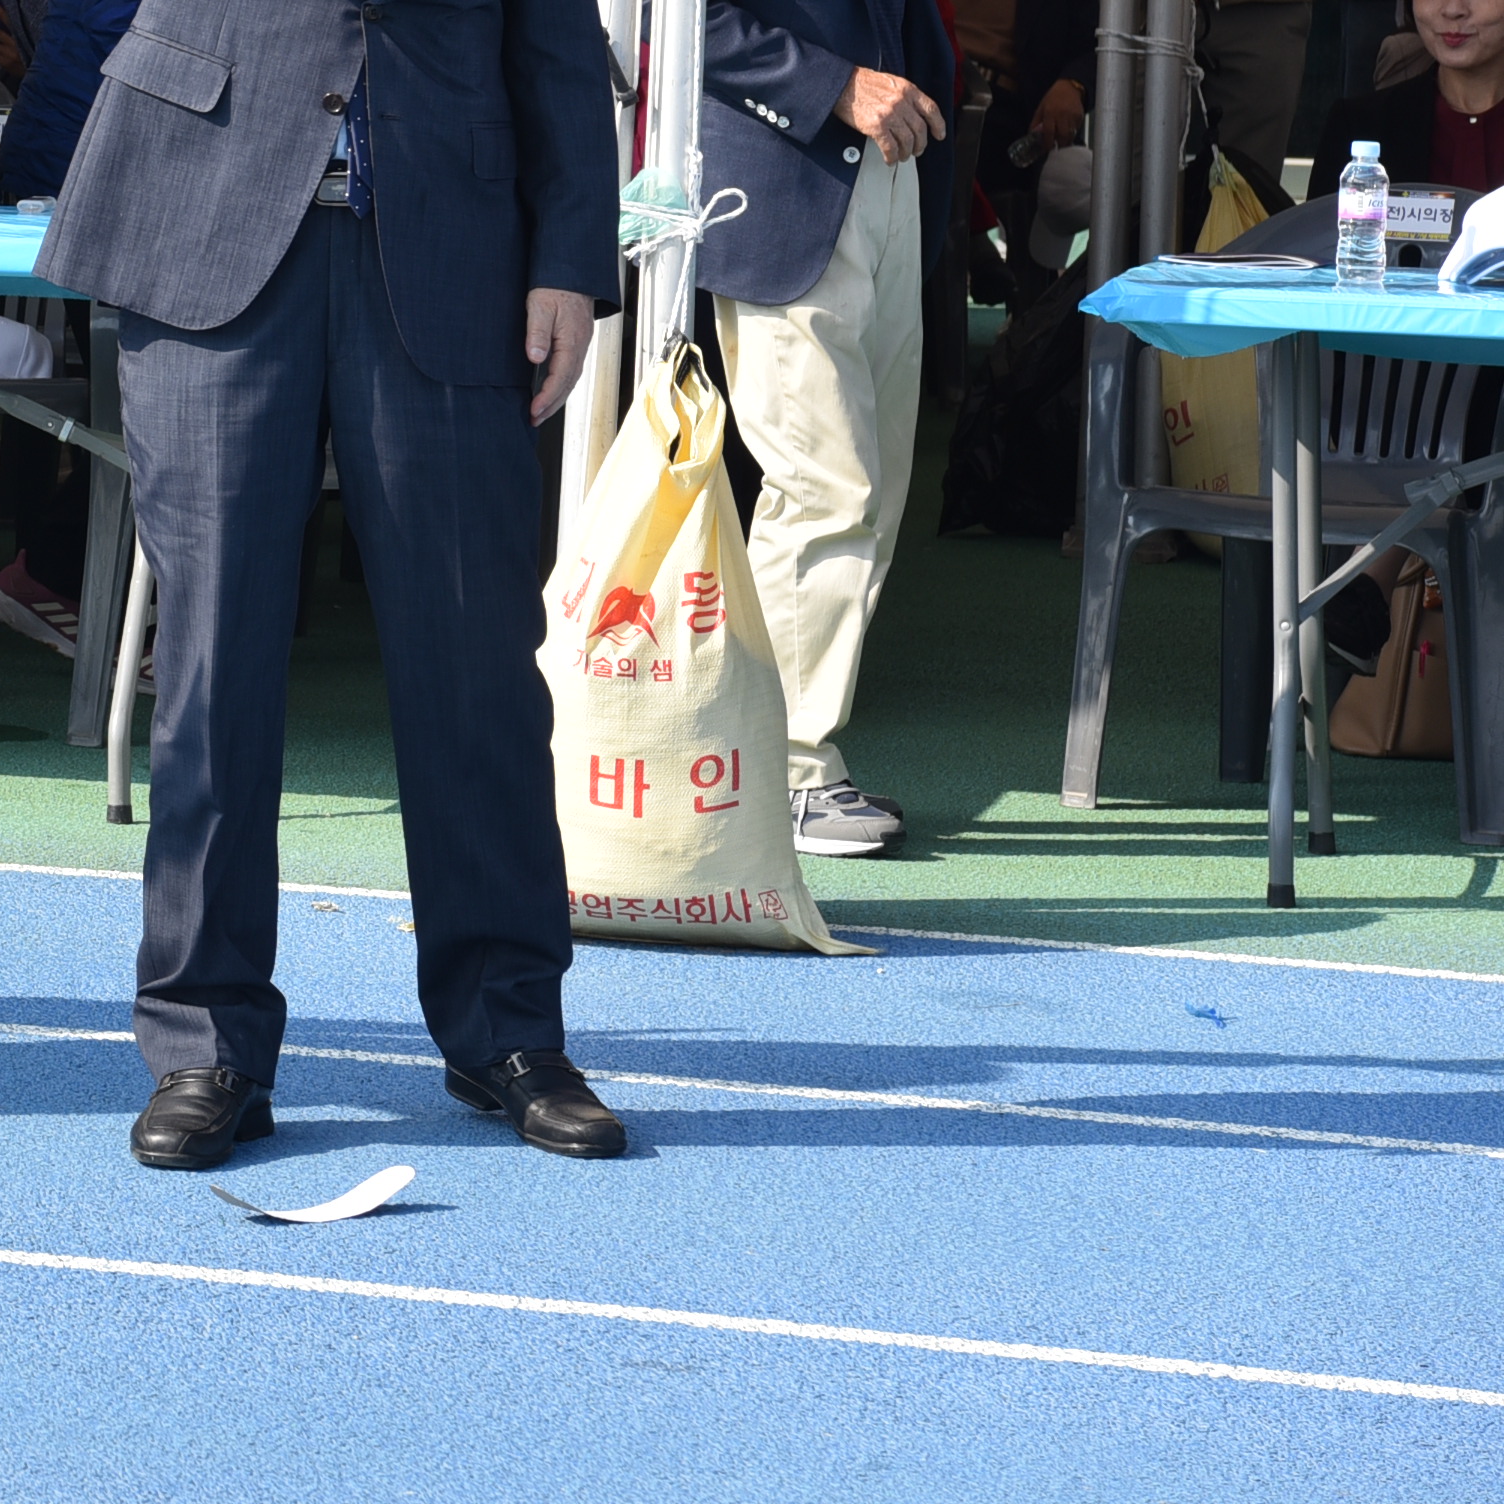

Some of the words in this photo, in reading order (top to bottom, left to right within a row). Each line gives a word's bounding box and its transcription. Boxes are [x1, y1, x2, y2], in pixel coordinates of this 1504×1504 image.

[650, 659, 674, 683] 샘
[589, 754, 651, 819] 바
[690, 748, 740, 814] 인
